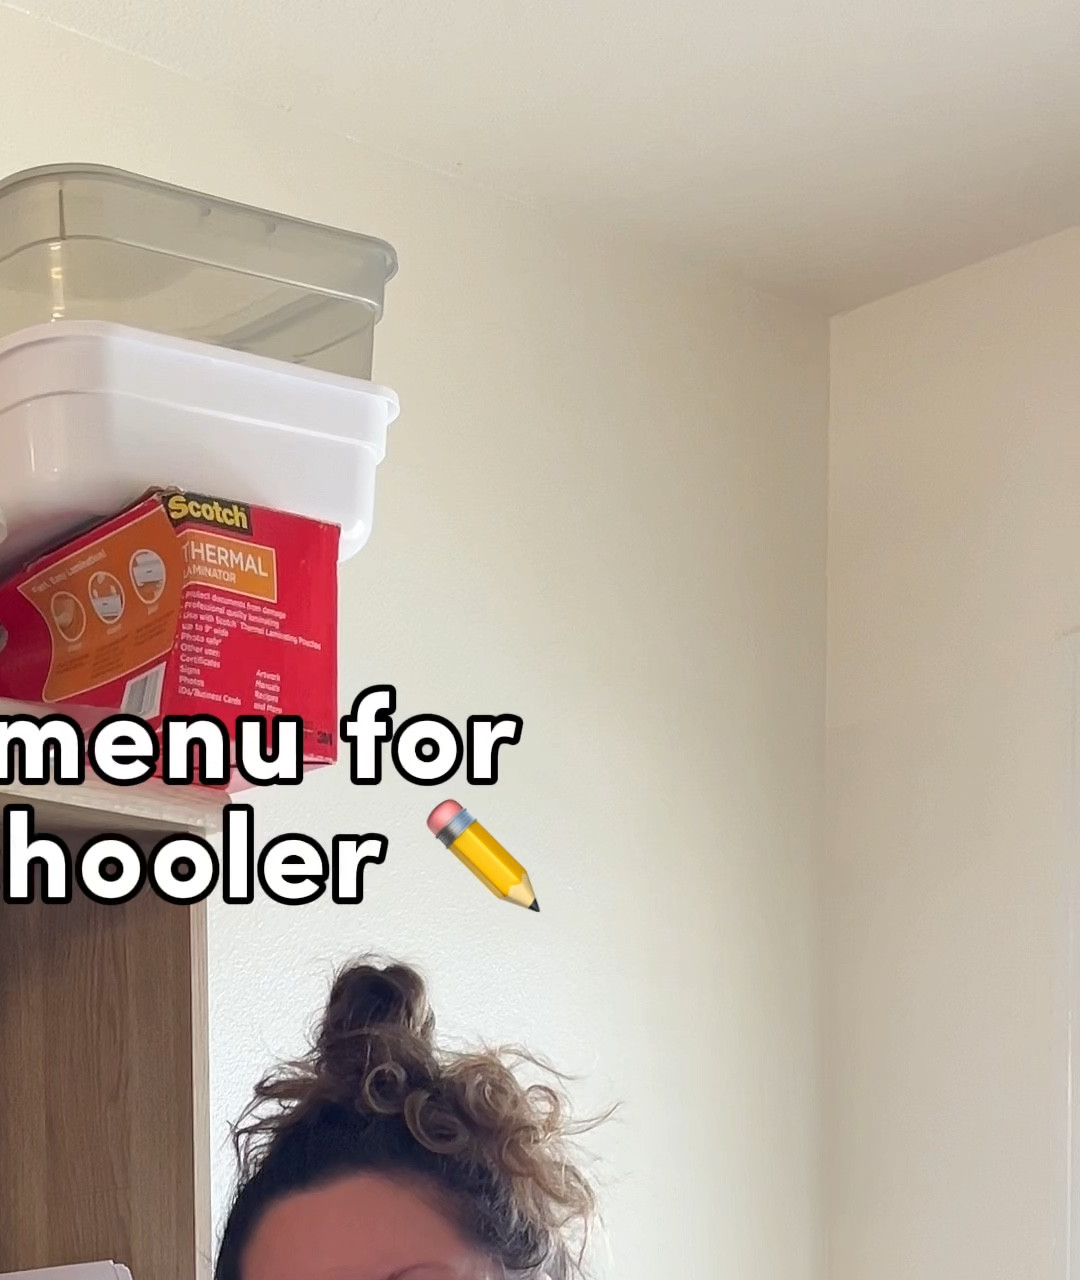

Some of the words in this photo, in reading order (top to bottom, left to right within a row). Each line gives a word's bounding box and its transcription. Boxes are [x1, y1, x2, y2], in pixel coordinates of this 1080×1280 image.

[167, 495, 248, 530] Scotch
[181, 540, 268, 578] THERMAL
[183, 564, 237, 583] LAMINATOR
